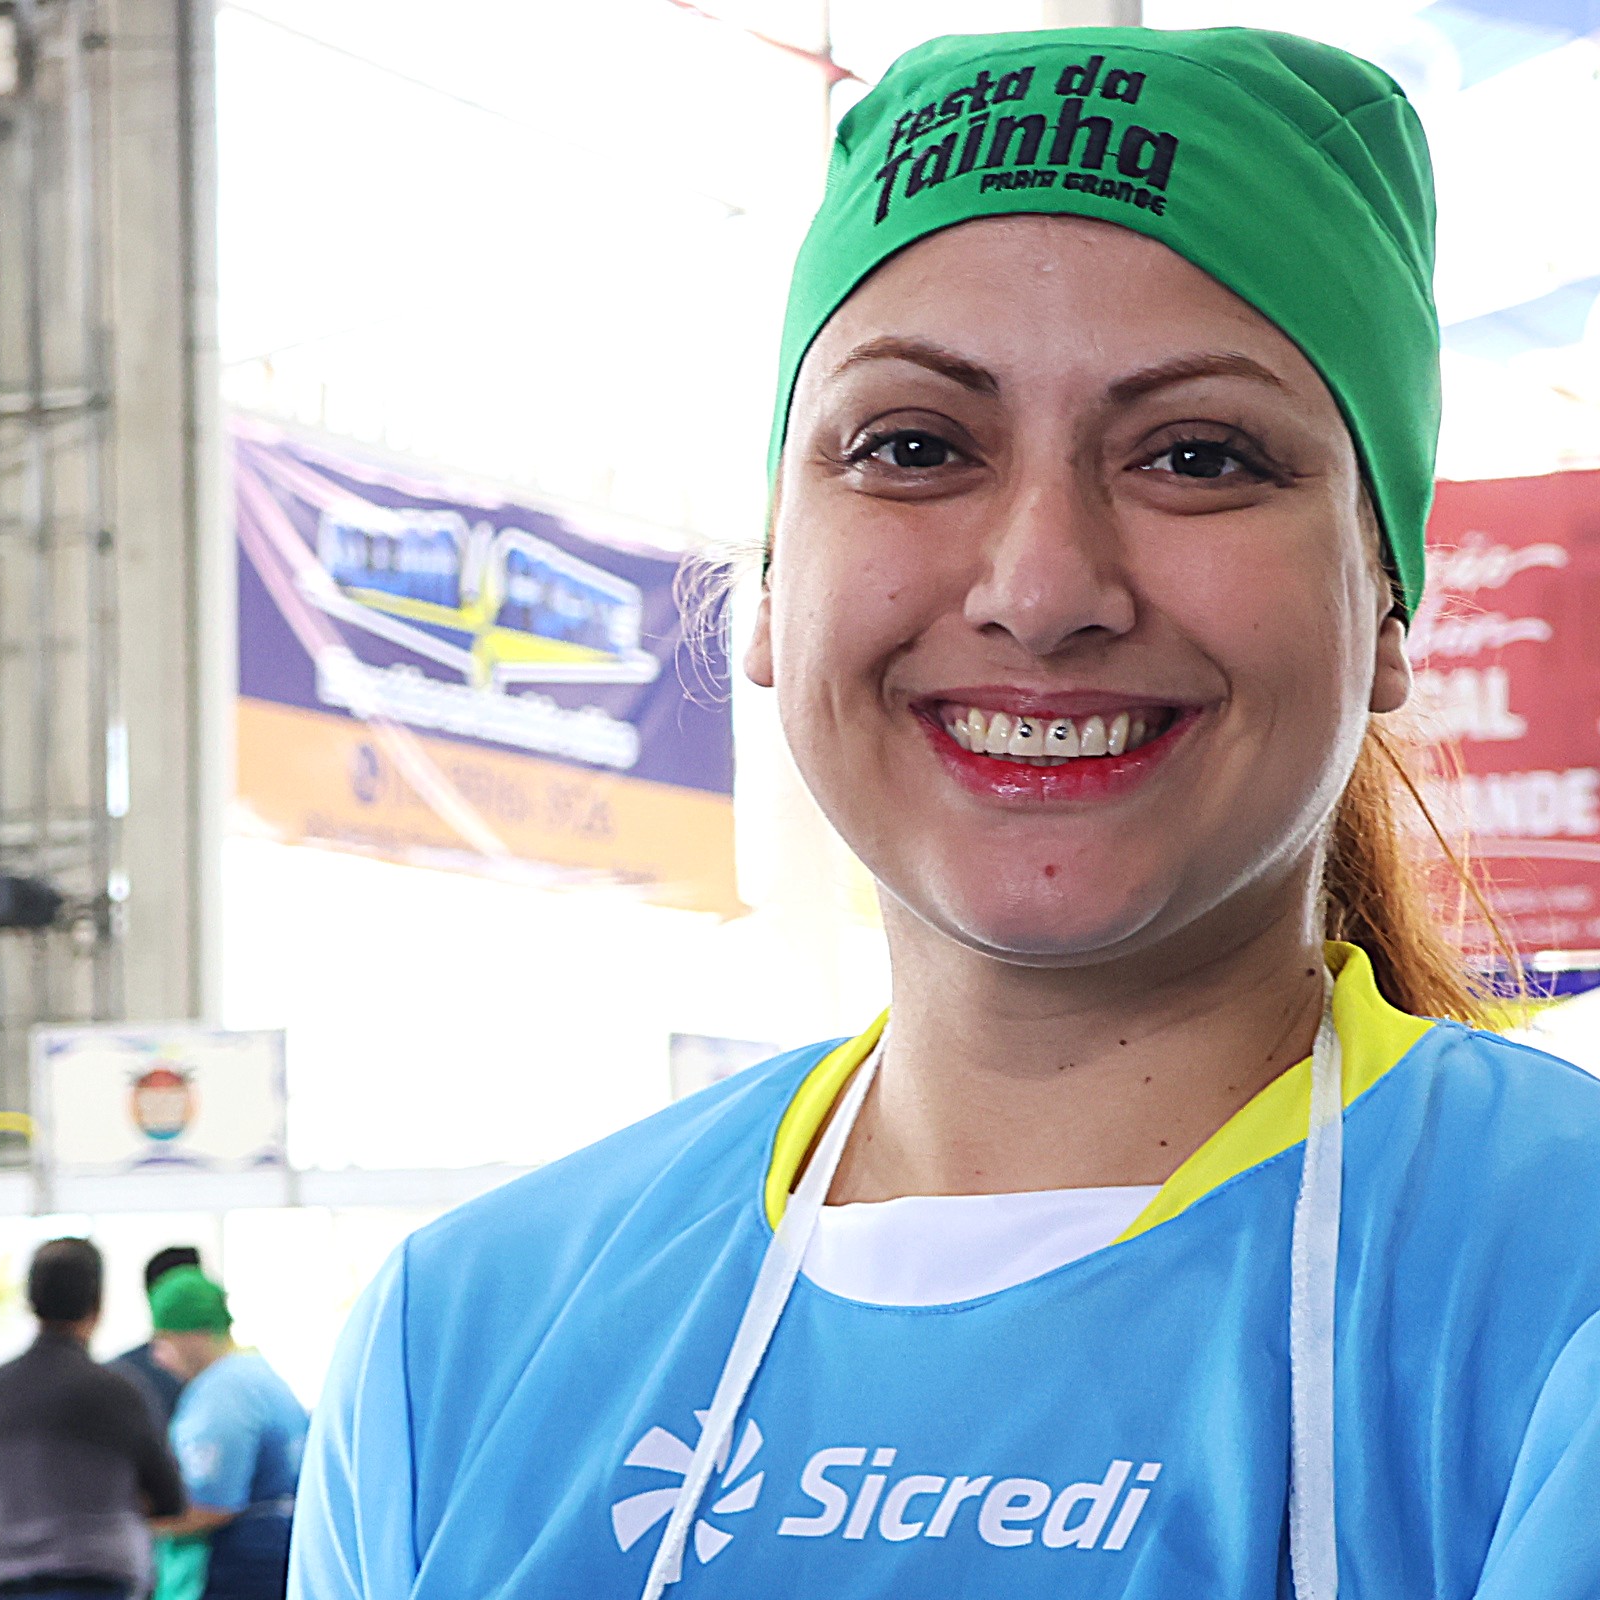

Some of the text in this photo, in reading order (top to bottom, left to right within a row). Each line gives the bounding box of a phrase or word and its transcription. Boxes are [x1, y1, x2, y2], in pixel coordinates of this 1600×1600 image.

[874, 98, 1179, 226] Tainha
[887, 55, 1147, 163] Festa da
[980, 169, 1168, 216] PRAIA GRANDE
[778, 1446, 1162, 1551] Sicredi
